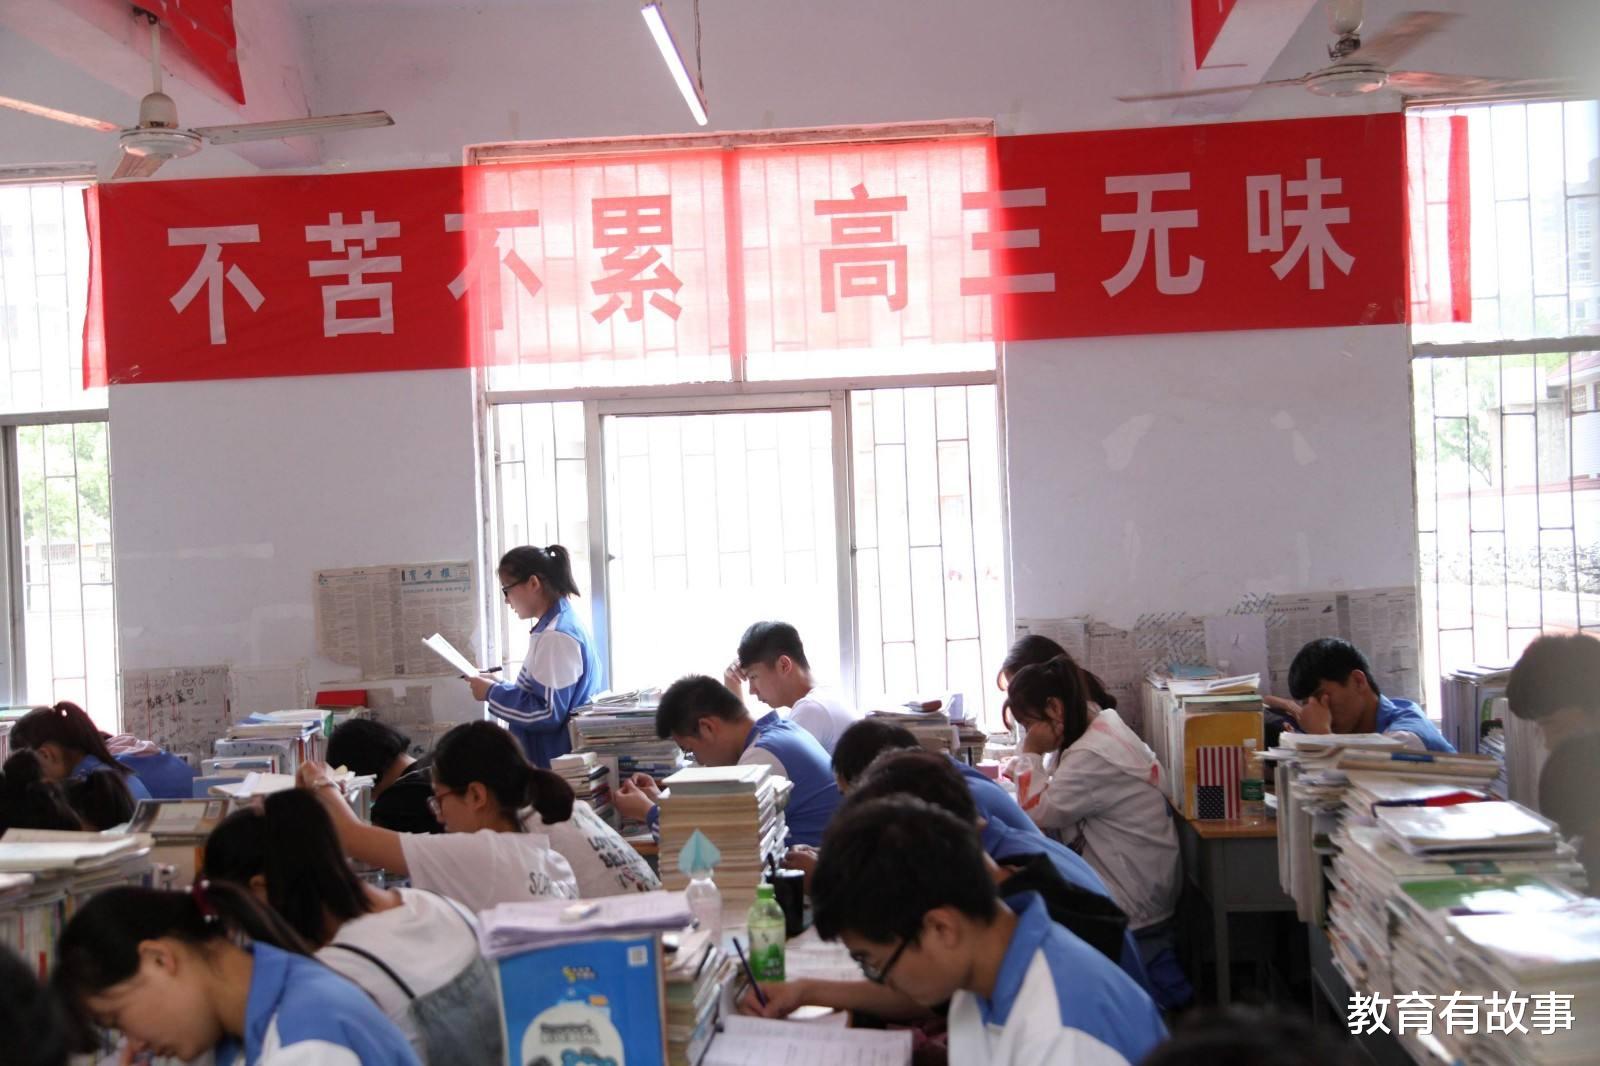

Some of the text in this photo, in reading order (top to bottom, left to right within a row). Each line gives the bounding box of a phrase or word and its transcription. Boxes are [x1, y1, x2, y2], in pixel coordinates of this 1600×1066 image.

[168, 157, 1355, 345] 不苦不累 高三无味
